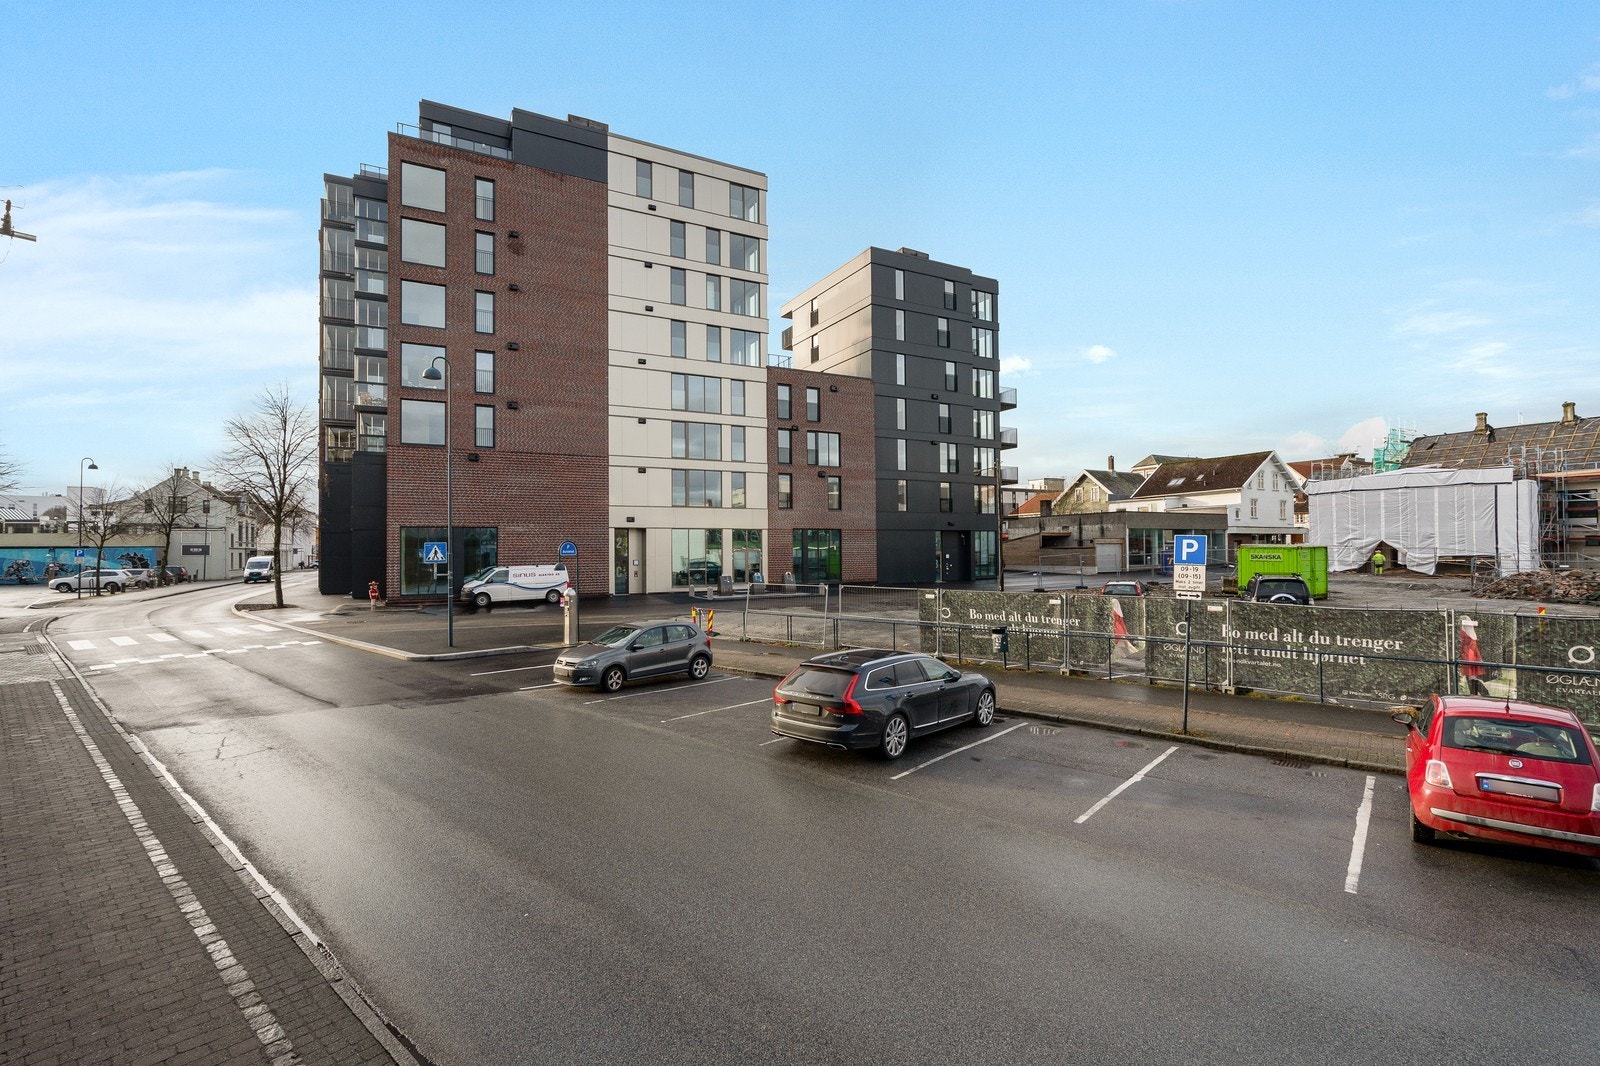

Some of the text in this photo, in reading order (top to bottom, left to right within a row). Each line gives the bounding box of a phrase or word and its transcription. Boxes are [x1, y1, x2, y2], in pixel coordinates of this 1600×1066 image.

[76, 549, 83, 557] P
[1181, 539, 1199, 561] P
[969, 608, 983, 620] Bo
[985, 611, 1006, 622] med
[1008, 611, 1021, 622] alt
[1025, 612, 1038, 624] du
[1245, 628, 1278, 642] med
[1283, 629, 1304, 644] alt
[1309, 630, 1330, 645] du
[1336, 635, 1404, 653] trenger
[1567, 645, 1595, 664] Ø
